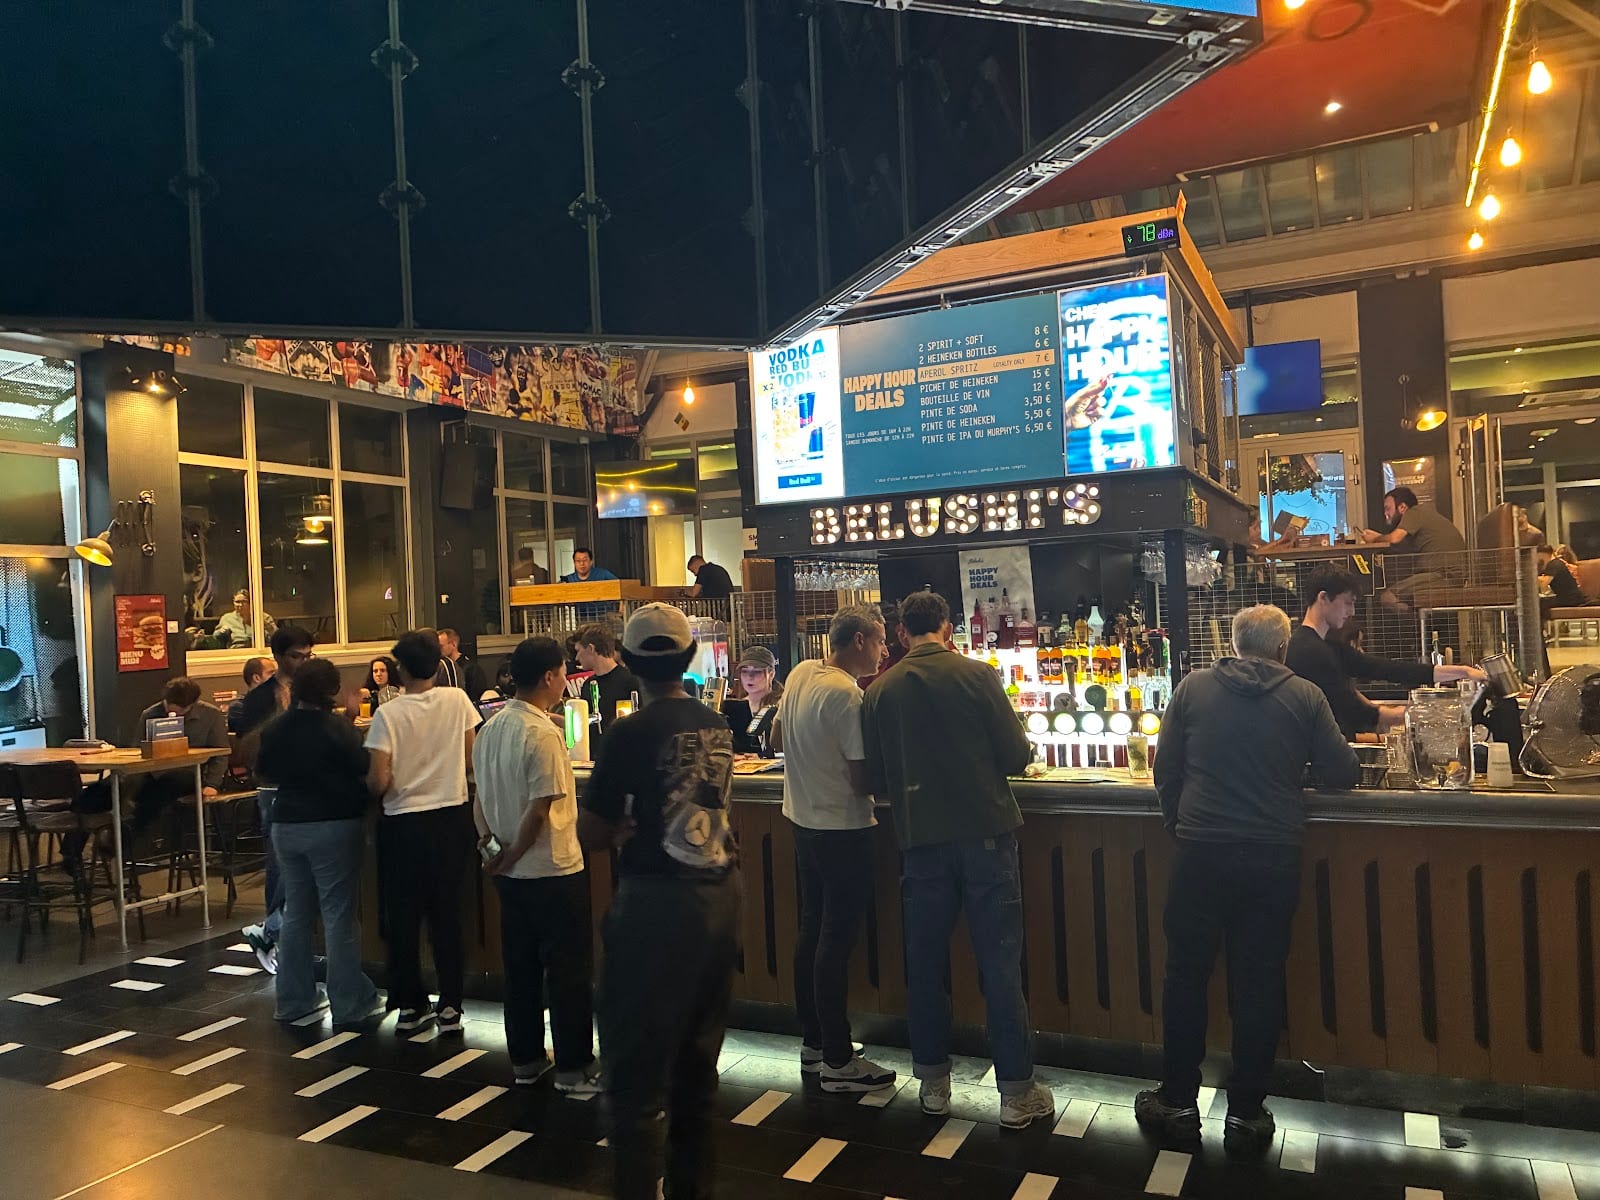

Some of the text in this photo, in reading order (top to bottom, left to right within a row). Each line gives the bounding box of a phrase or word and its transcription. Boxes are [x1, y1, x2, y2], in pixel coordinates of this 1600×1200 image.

[1137, 223, 1155, 242] 78
[919, 344, 924, 353] 2
[927, 339, 953, 351] SPIRIT
[965, 335, 984, 345] SOFT
[1034, 326, 1040, 336] 8
[1043, 325, 1049, 335] €
[769, 339, 825, 367] VODKA
[919, 338, 1050, 365] 2 HEINEKEN BOTTLES 6 €
[770, 363, 788, 375] RED
[920, 368, 947, 380] APEROL
[951, 363, 978, 375] SPRITZ
[1035, 354, 1041, 363] 7
[1044, 353, 1050, 362] €
[844, 368, 917, 394] HAPPY HOUR
[920, 368, 1050, 393] PICHET DE HEINEKEN 15 €
[855, 388, 905, 412] DEALS
[920, 381, 1051, 406] BOUTEILLE DE VIN 12 €
[921, 394, 1051, 419] PINTE DE SODA 3,50 €
[921, 408, 1052, 432] PINTE DE HEINEKEN 5,50 €
[922, 421, 1052, 445] PINTE DE IPA OU MURPHY'S 6,50 €
[810, 482, 1101, 545] BELUSHI'S
[968, 567, 998, 576] HAPPY
[969, 574, 994, 582] HOUR
[970, 580, 998, 589] DEALS
[120, 650, 144, 659] MENU
